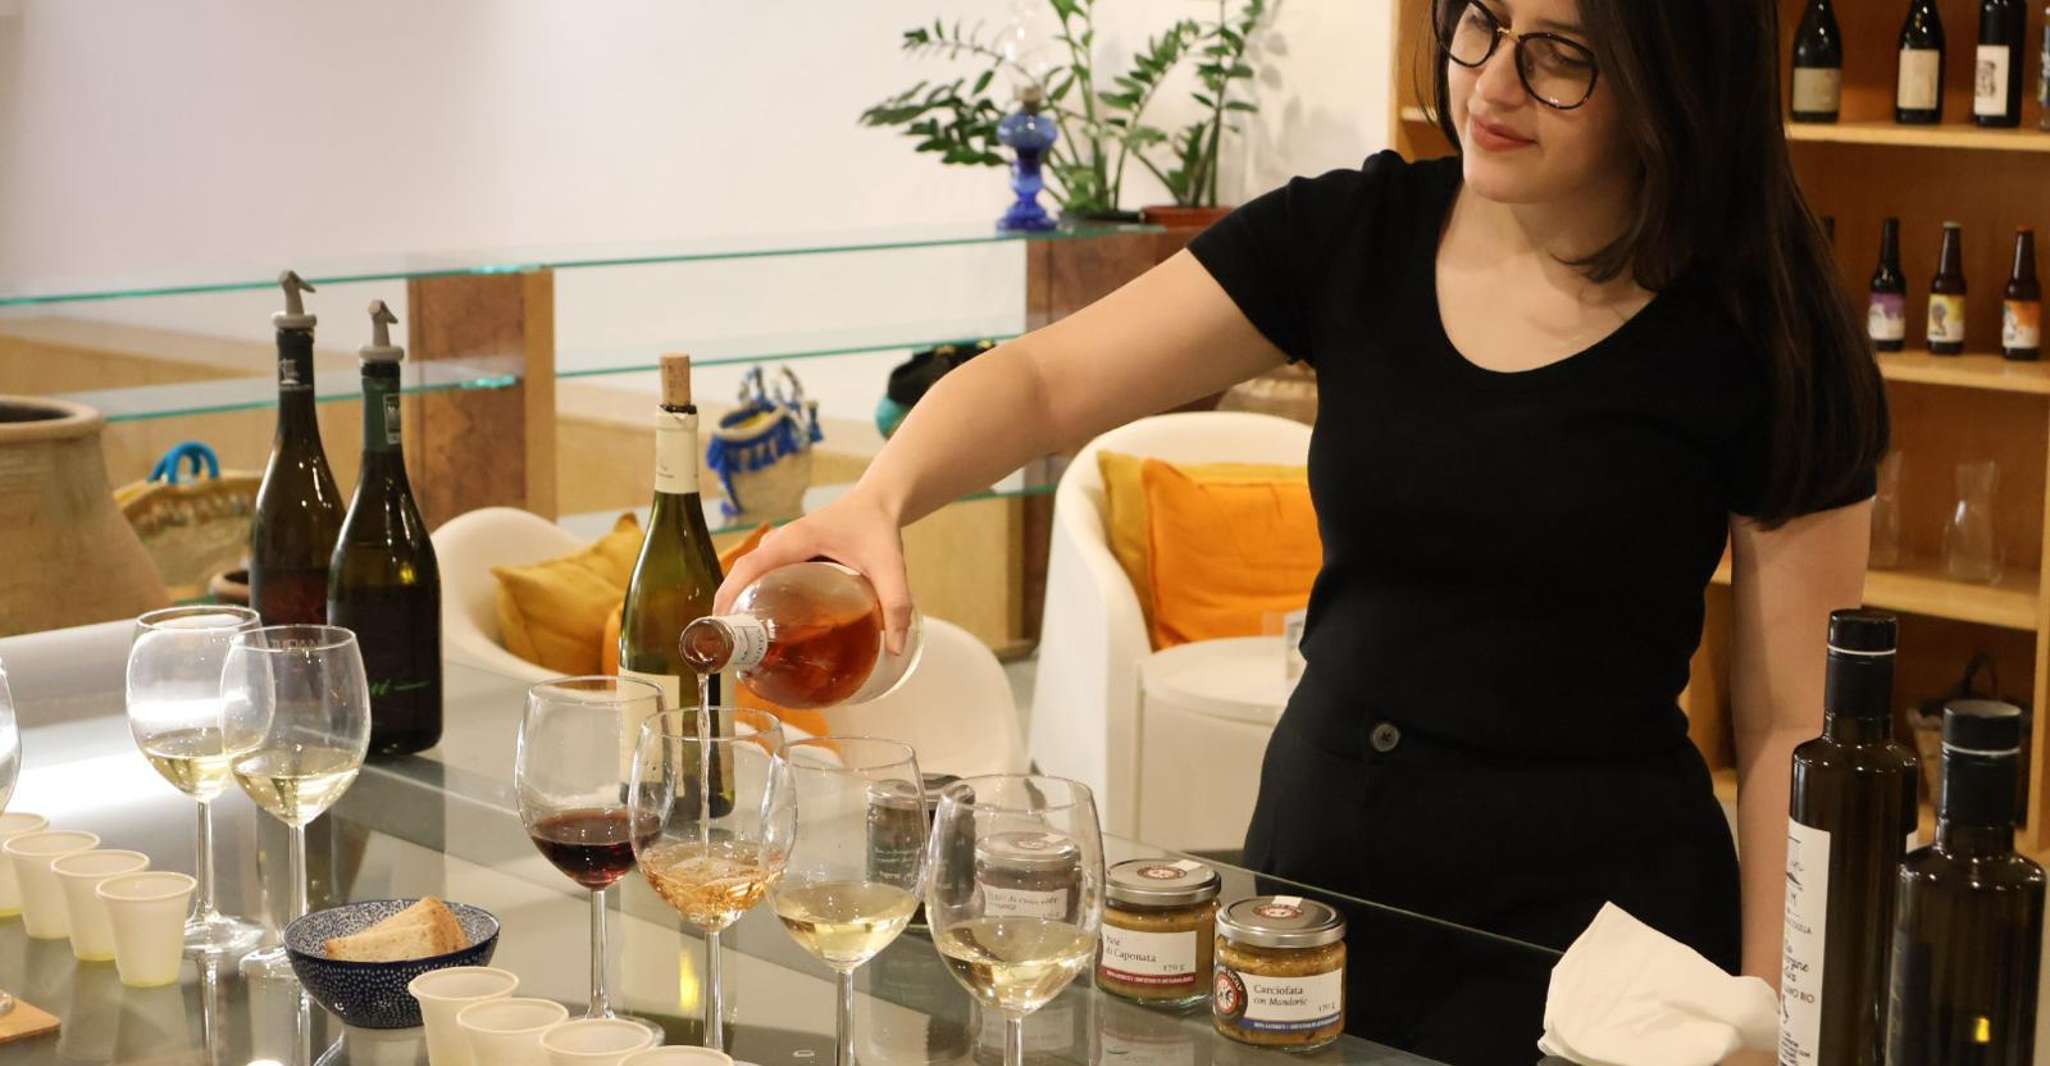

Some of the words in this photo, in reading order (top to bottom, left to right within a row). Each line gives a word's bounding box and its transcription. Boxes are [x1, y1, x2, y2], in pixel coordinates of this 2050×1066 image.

[1114, 948, 1157, 962] Caponata
[1254, 984, 1304, 996] Carciofata
[1253, 997, 1267, 1005] con
